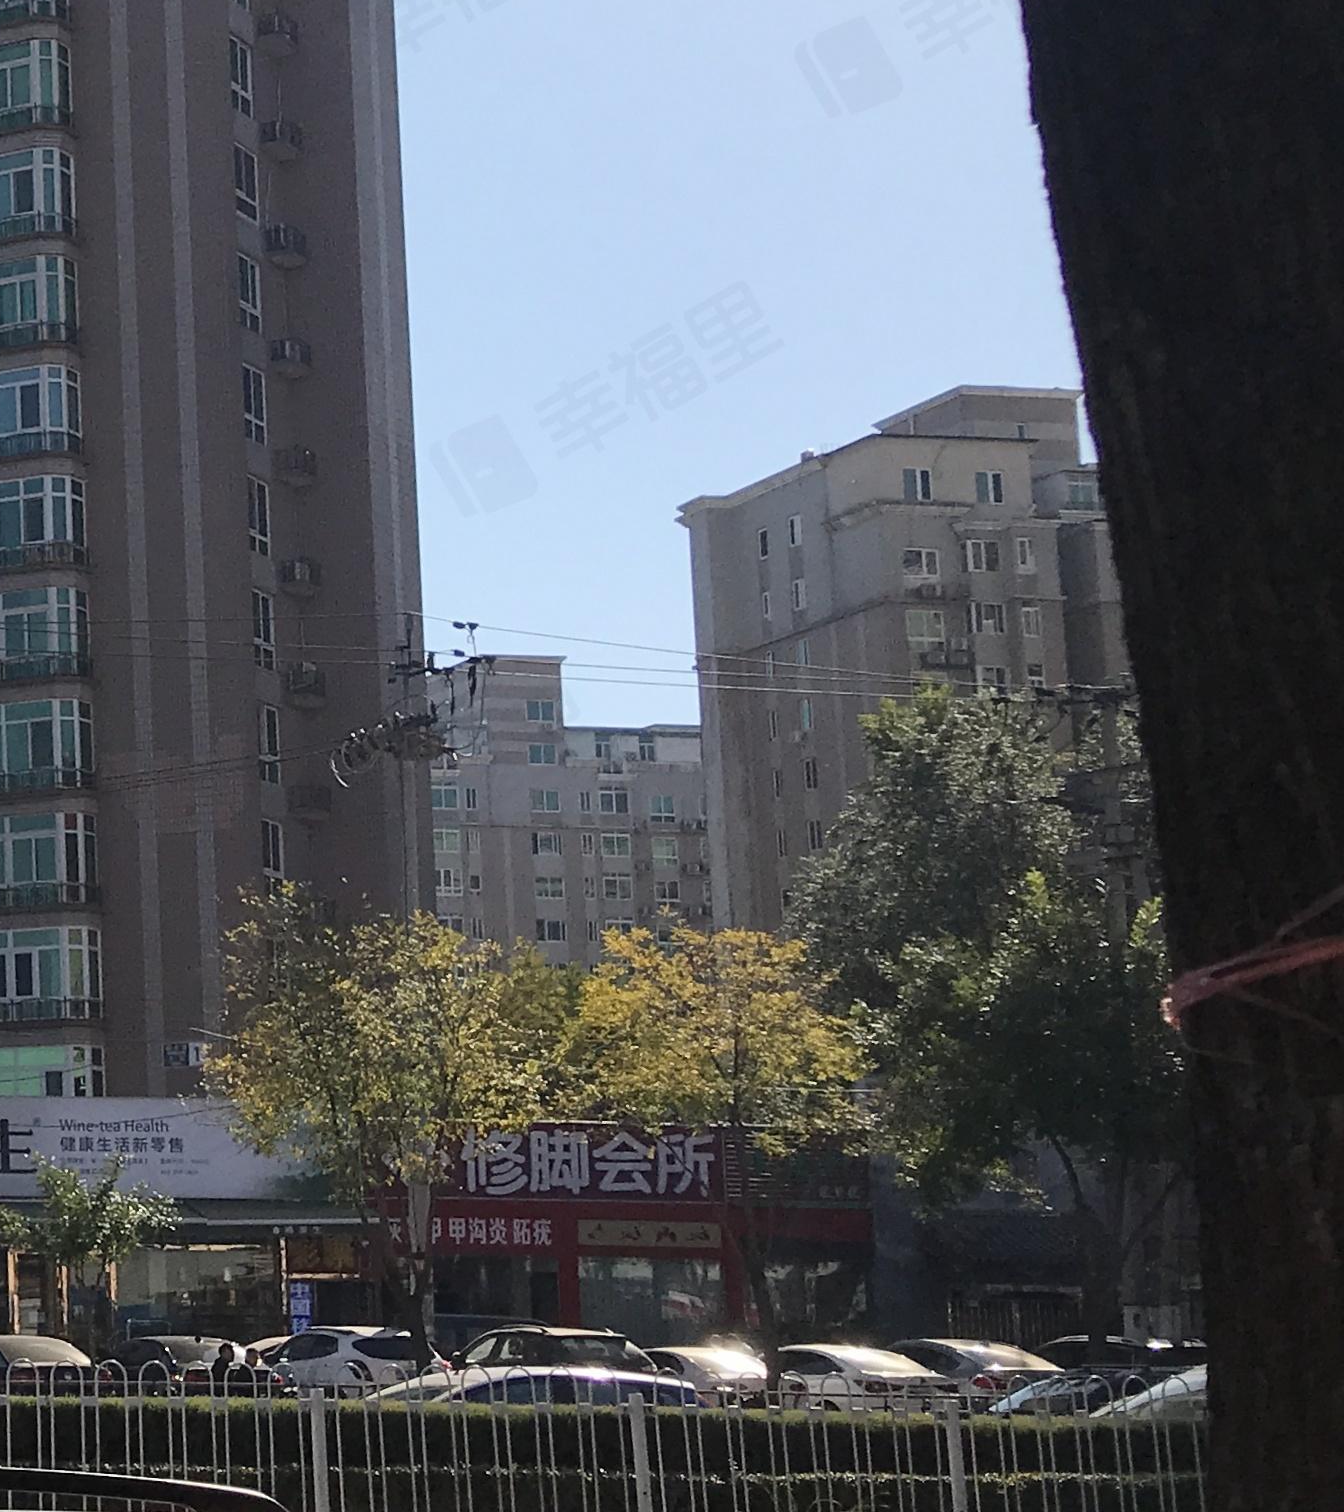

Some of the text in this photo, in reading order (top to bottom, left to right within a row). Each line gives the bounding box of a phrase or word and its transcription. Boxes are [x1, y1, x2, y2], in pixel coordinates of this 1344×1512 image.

[59, 1119, 170, 1133] Wine-tea Health
[59, 1137, 184, 1154] 健康生活新零售
[381, 1127, 715, 1198] 修脚会所
[449, 1217, 508, 1245] 甲沟炎
